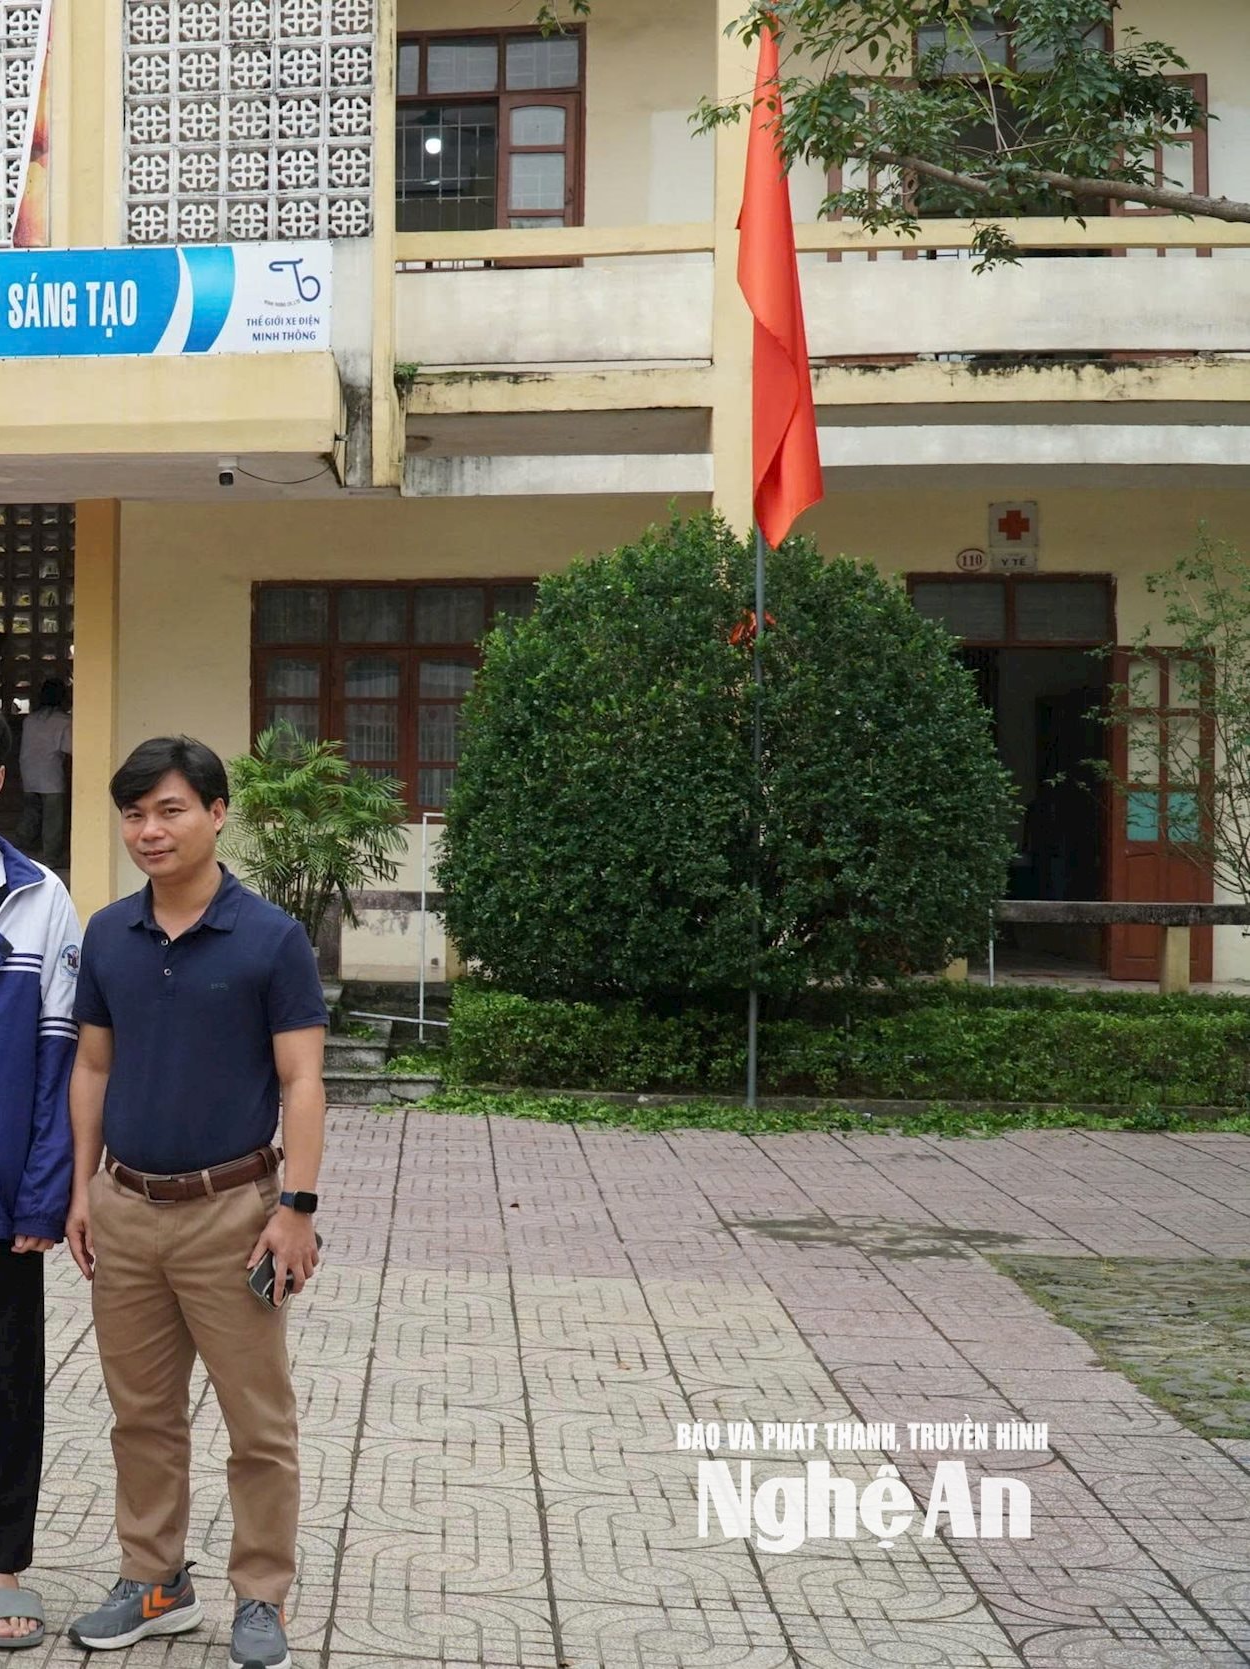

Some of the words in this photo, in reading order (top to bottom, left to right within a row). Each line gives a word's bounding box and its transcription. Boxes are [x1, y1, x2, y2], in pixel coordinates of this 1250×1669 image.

[8, 272, 77, 328] SÁNG
[86, 280, 137, 338] TẠO
[246, 315, 262, 327] THẾ
[265, 315, 284, 326] GIỚI
[286, 317, 297, 325] XE
[299, 314, 320, 326] ĐIỆN
[252, 332, 280, 341] MINH
[283, 329, 316, 340] THÔNG
[962, 554, 983, 567] 110
[1001, 558, 1009, 566] Y
